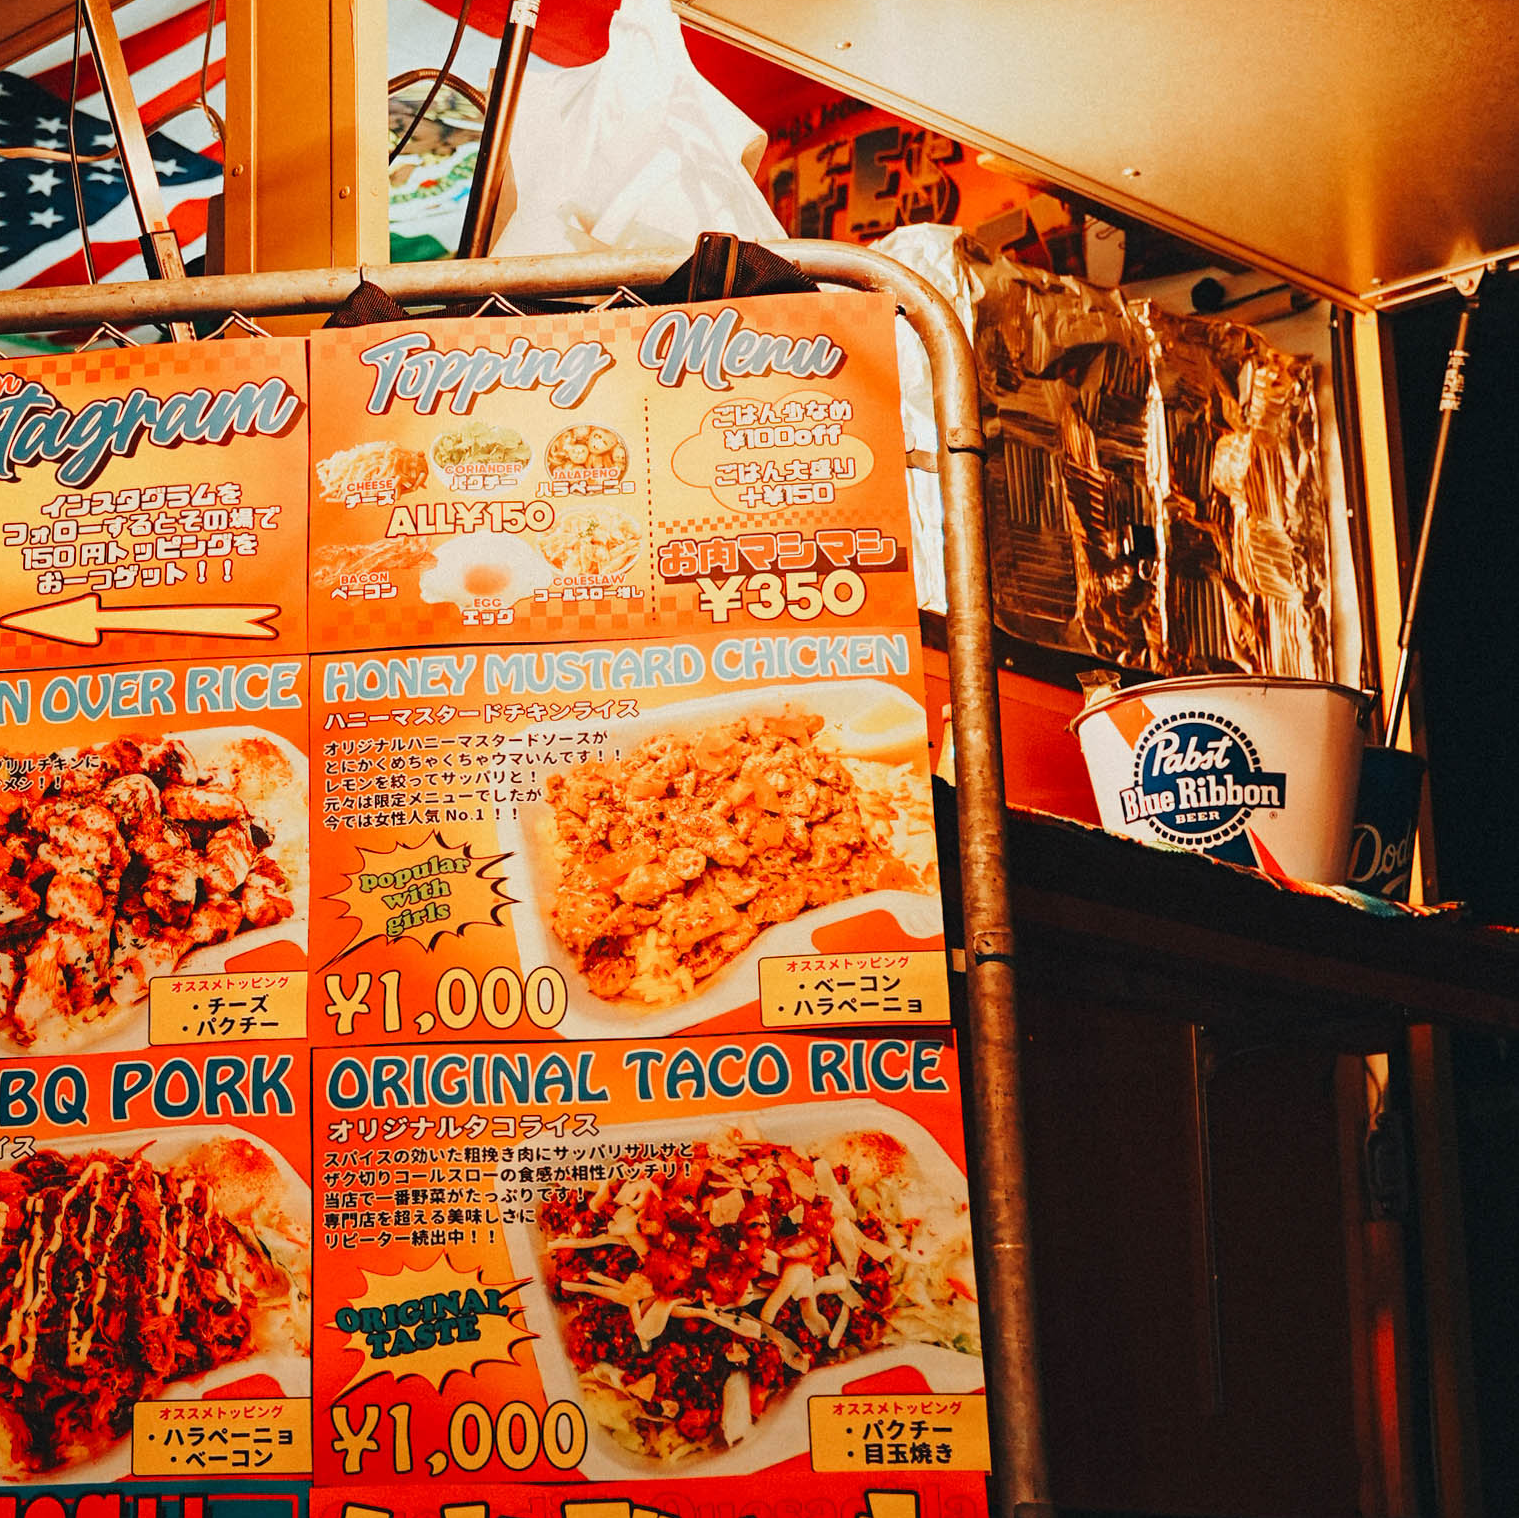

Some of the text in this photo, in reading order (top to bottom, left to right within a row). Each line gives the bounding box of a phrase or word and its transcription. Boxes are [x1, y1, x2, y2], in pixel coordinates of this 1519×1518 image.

[360, 307, 842, 416] Topping Menu
[713, 400, 852, 428] ごはん少なめ
[724, 424, 842, 450] ¥100off
[444, 463, 522, 474] CORIANDER
[450, 475, 518, 490] パクチー
[553, 468, 619, 479] JALAPENO
[715, 458, 856, 486] ごはん大盛り
[345, 490, 396, 509] チーズ
[346, 479, 394, 492] CHEESE
[536, 479, 635, 497] ハラペーニョ
[41, 482, 242, 518] インスタグラムを
[3, 506, 281, 546] フォローするとその場で
[658, 529, 898, 578] お肉マシマシ
[331, 584, 398, 600] ベーコン
[341, 572, 389, 584] BACON
[553, 573, 626, 586] COLESLAW
[473, 598, 502, 608] EGG
[696, 568, 867, 623] ¥350
[462, 610, 515, 625] エッグ
[322, 634, 910, 704] HONEY MUSTARD CHICKEN
[40, 672, 179, 726] OVER
[185, 662, 302, 712] RICE
[324, 698, 640, 731] ハニーマスタードチキンライス
[324, 731, 608, 757] オリジナルハニーマスタードソースが
[1151, 730, 1233, 778] Pabst
[324, 788, 542, 812] 元々は限定メニューでしたが
[1121, 773, 1281, 823] Blue Ribbon
[1175, 811, 1220, 823] BEER
[359, 855, 471, 893] popular
[382, 878, 451, 910] with
[386, 903, 450, 938] girls
[785, 956, 910, 972] オススメトッピング
[171, 976, 289, 993] オススメトッピング
[325, 966, 567, 1036] ¥1,000
[110, 1055, 296, 1123] PORK
[327, 1041, 948, 1112] ORIGINAL TACO RICE
[328, 1113, 600, 1143] オリジナルタコライス
[324, 1143, 694, 1168] スパイスの効いた粗挽き肉にサッパリサルサと
[324, 1209, 535, 1229] 専門店を超える美味しさに
[335, 1289, 509, 1333] ORIGINAL
[366, 1314, 481, 1359] TASTE
[158, 1405, 284, 1421] オススメトッピング
[832, 1401, 963, 1416] オススメトッピング
[331, 1400, 587, 1477] ¥1,000
